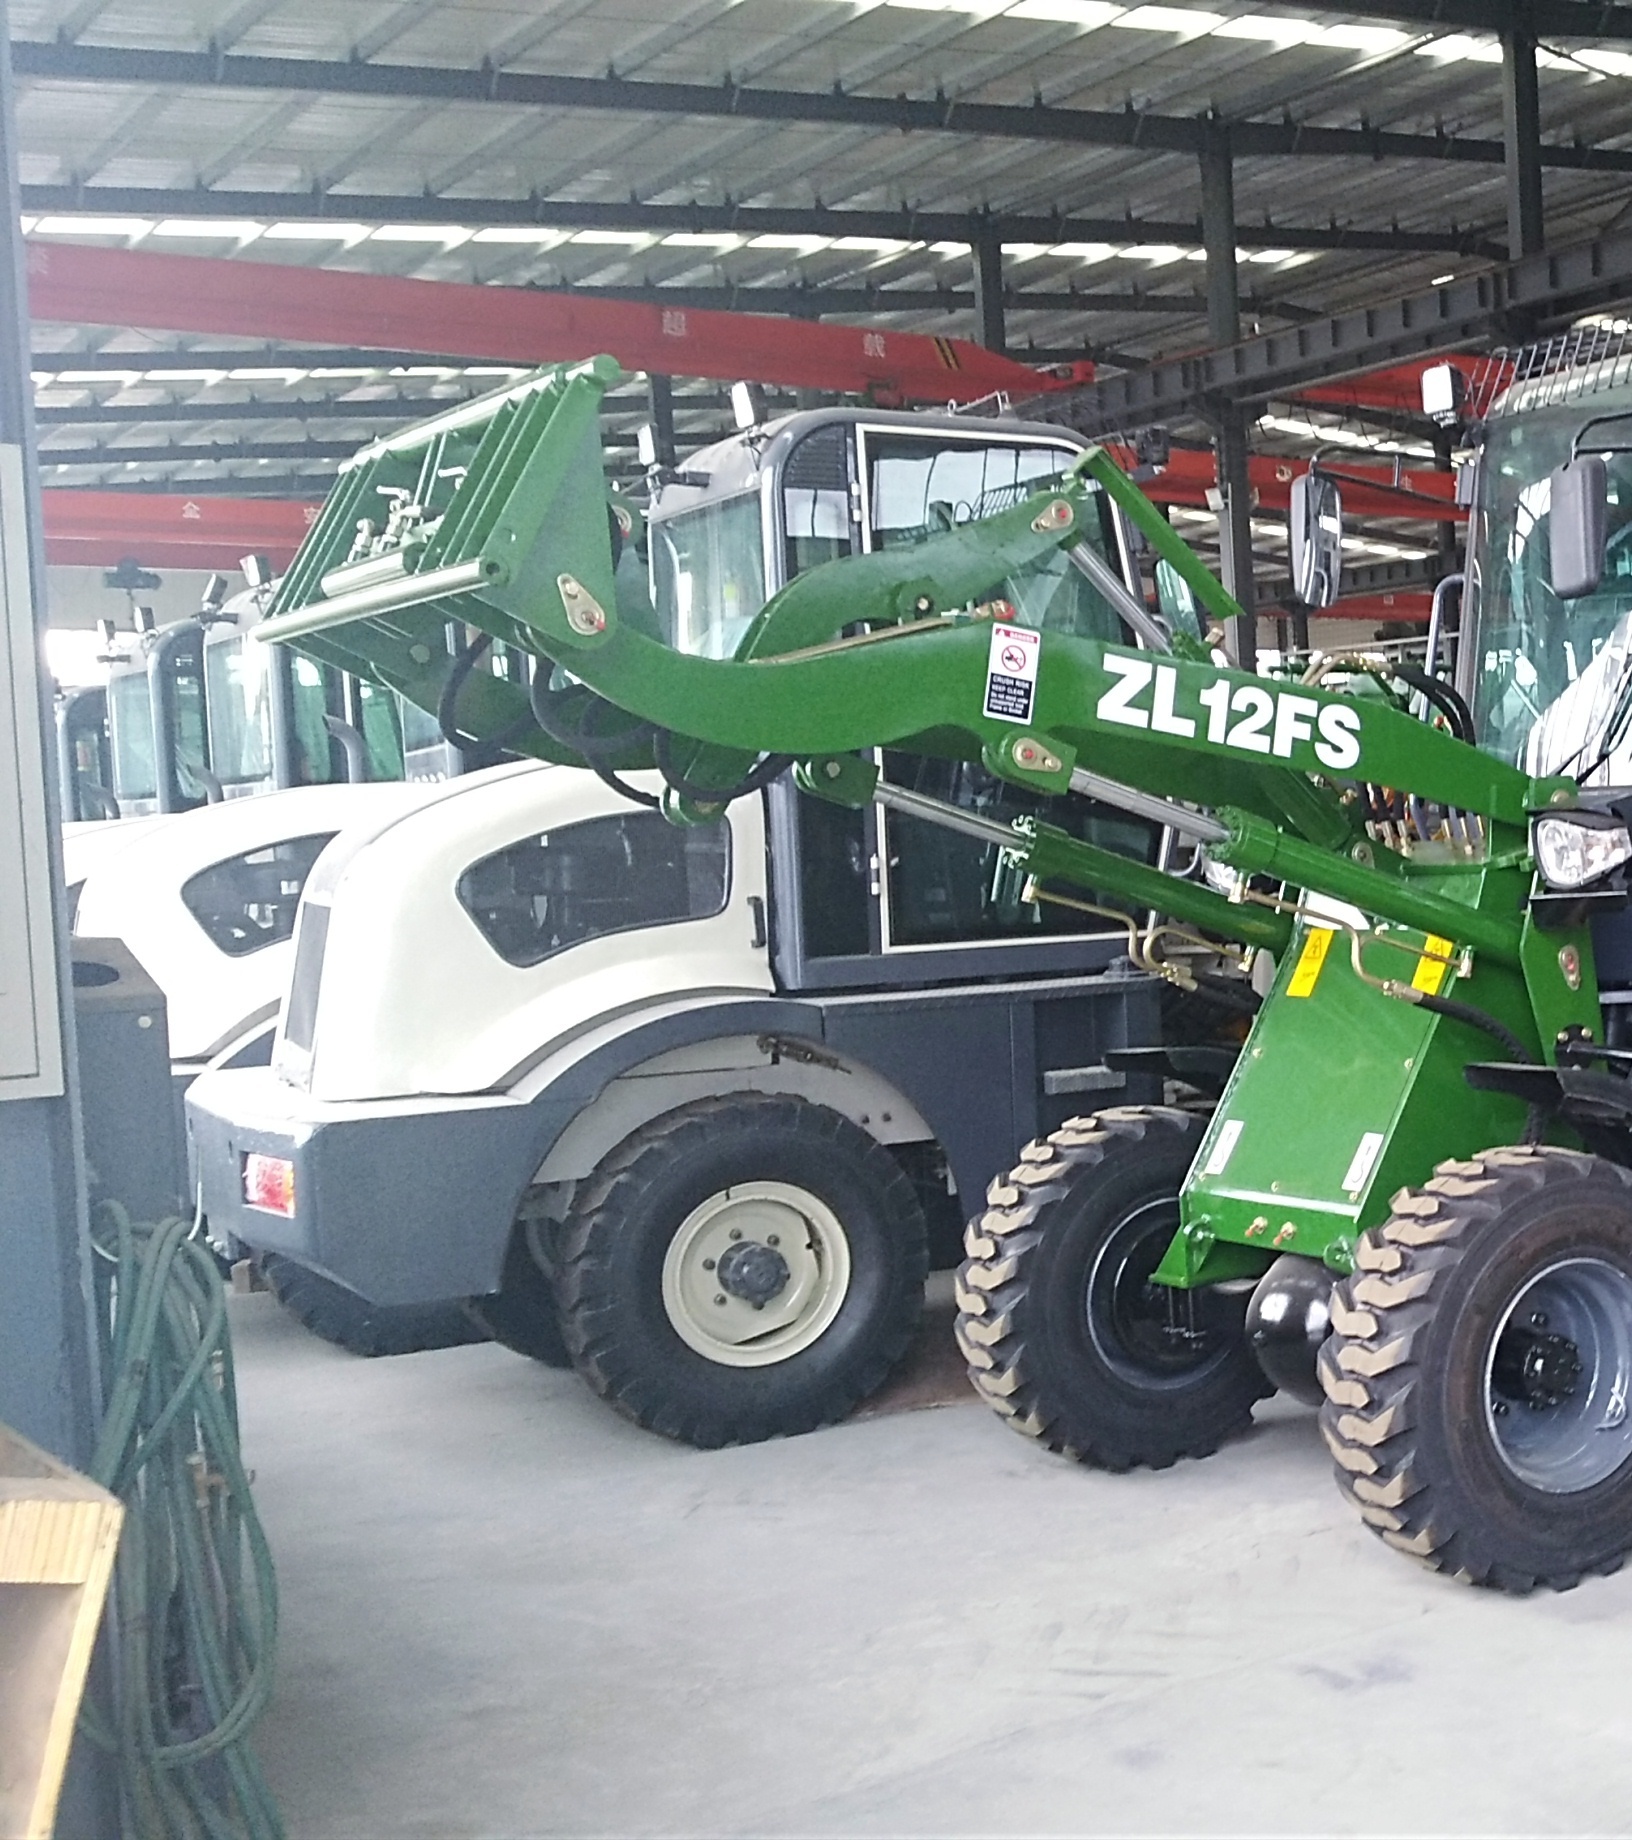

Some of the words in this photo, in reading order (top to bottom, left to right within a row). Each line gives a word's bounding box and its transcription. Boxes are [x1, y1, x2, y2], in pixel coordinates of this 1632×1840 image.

[992, 683, 1006, 692] KEEP
[1006, 686, 1024, 696] CLEAR
[993, 675, 1014, 686] CRUSH
[1015, 680, 1030, 690] RISK
[1097, 653, 1361, 769] ZL12FS
